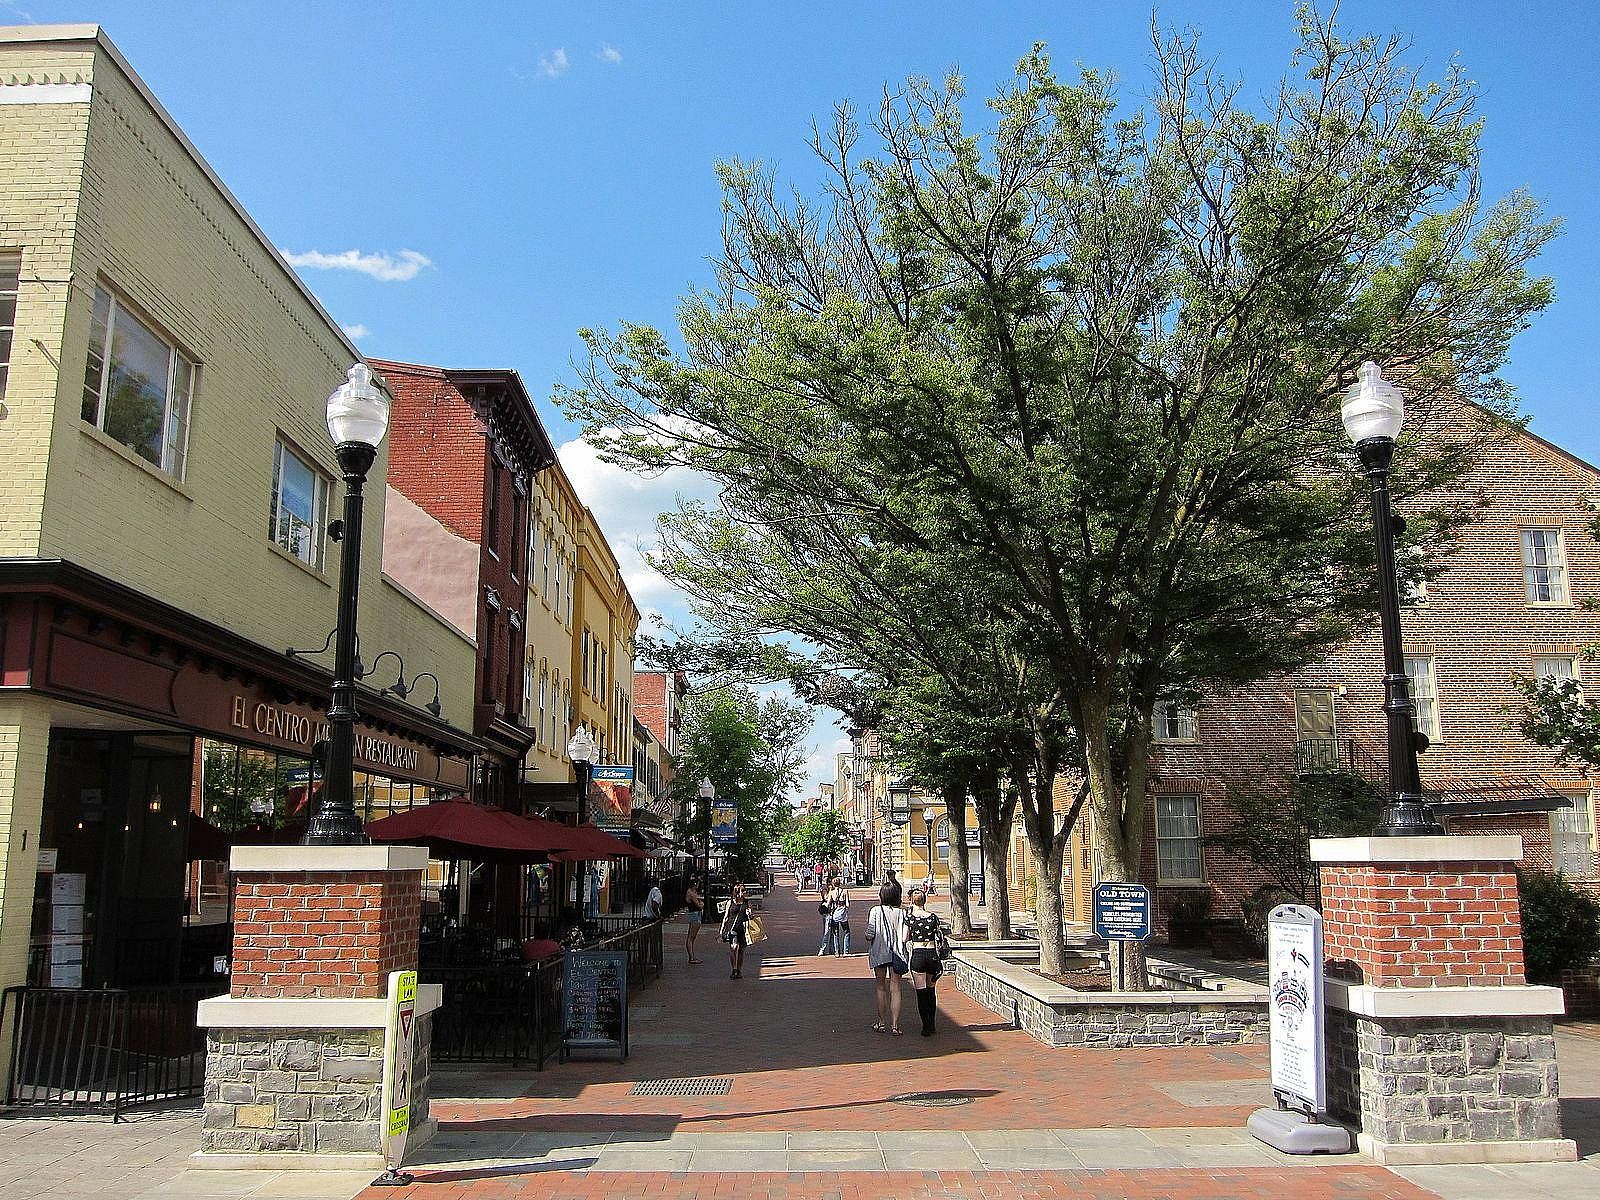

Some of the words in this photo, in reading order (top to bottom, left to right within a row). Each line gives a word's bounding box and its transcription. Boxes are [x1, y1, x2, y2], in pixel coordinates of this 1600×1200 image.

[232, 696, 249, 729] EL
[255, 703, 310, 745] CENTRO
[365, 737, 419, 770] RESTAURANT
